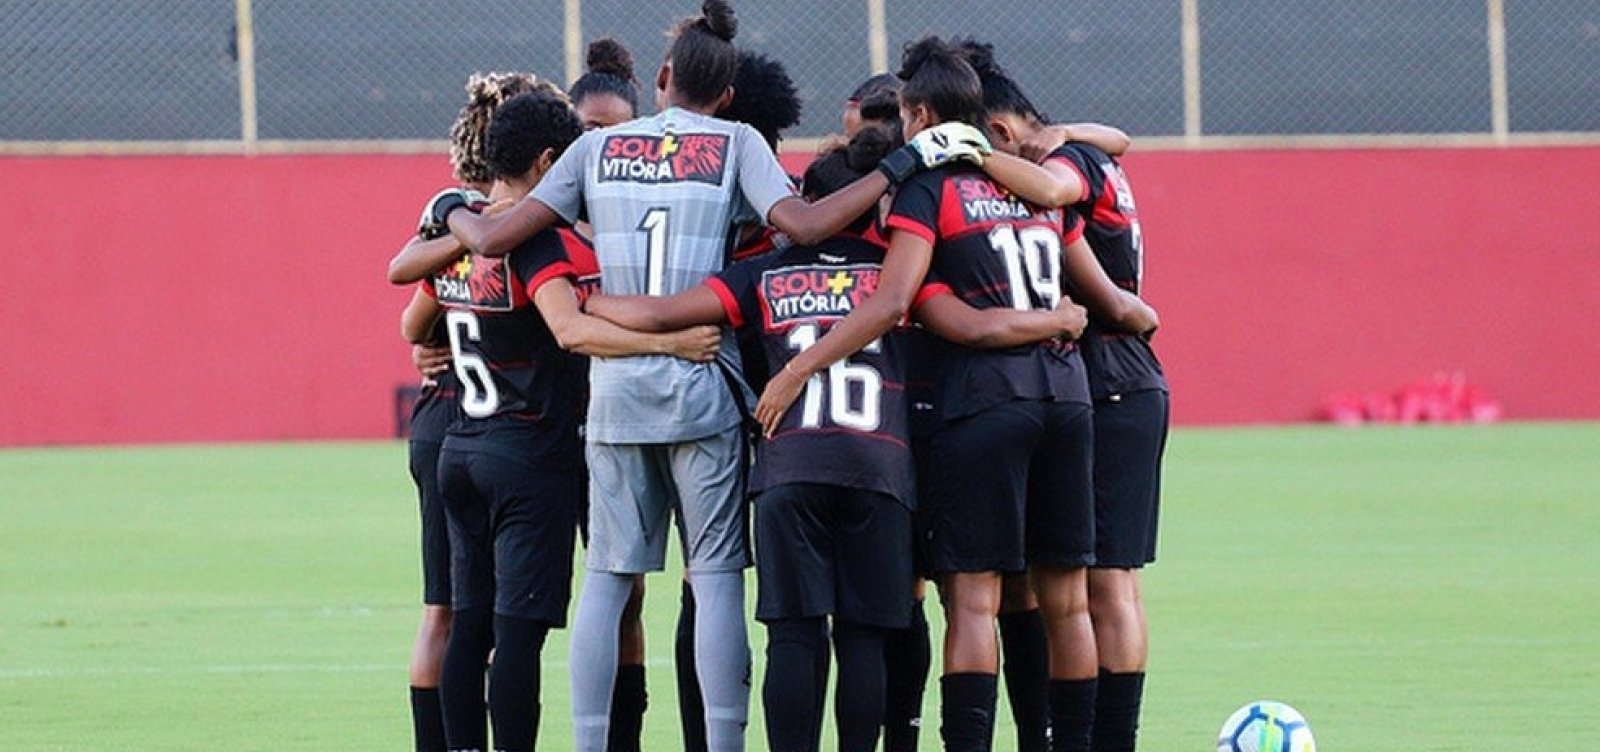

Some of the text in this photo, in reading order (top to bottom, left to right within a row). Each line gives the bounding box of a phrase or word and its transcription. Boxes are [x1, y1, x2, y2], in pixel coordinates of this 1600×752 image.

[637, 206, 670, 297] 1
[988, 223, 1063, 311] 19
[771, 290, 851, 317] VITÓRIA
[446, 311, 499, 419] 6
[788, 323, 882, 432] 16
